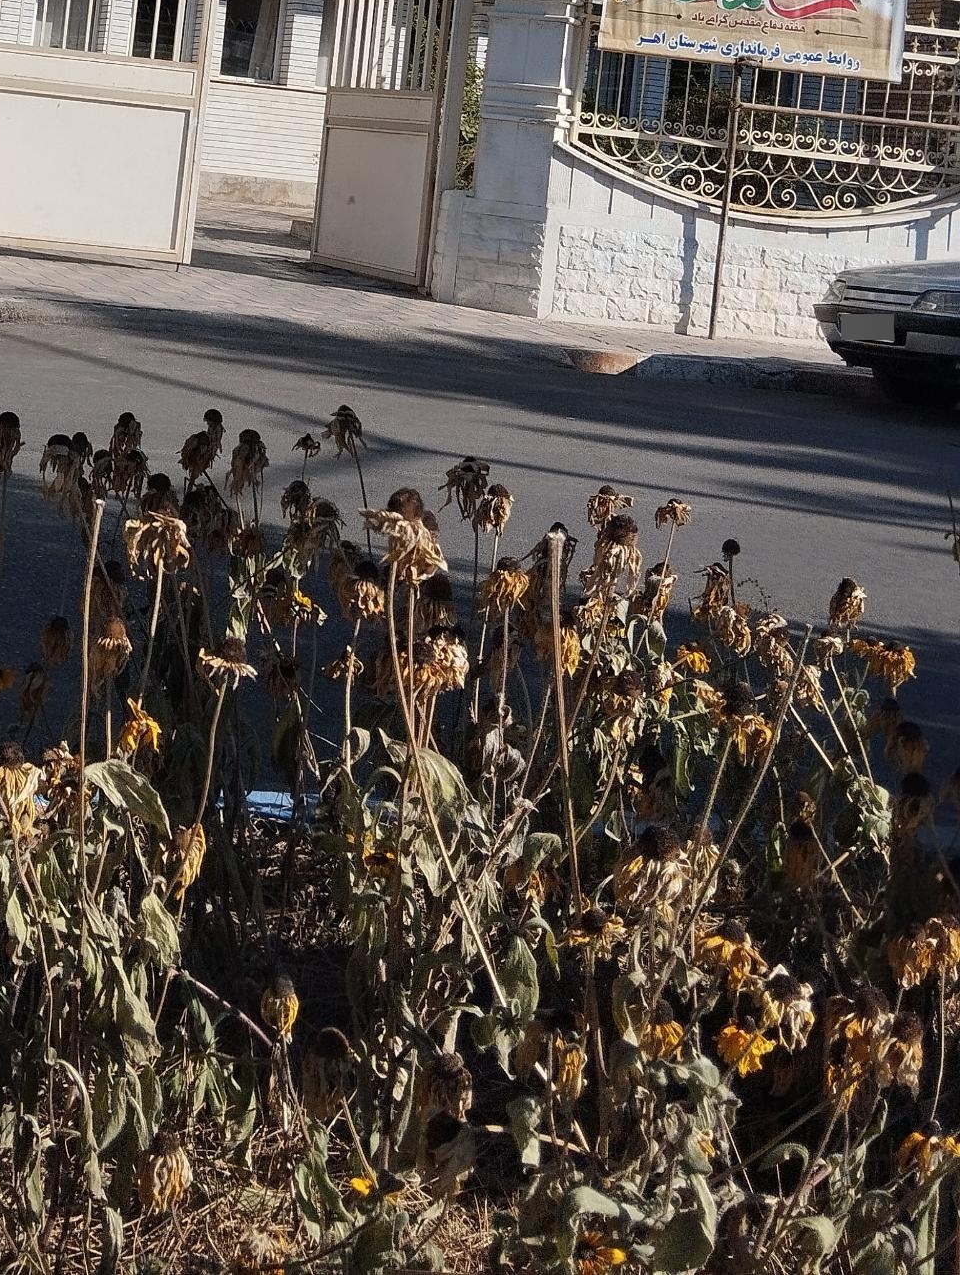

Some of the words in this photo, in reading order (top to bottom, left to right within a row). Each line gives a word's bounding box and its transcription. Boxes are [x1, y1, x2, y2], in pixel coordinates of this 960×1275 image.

[691, 12, 705, 25] باد
[728, 16, 762, 29] مقدس
[761, 19, 783, 34] دفاع
[783, 22, 806, 33] هفته
[636, 32, 666, 47] اهر
[668, 36, 718, 53] شهرستان
[720, 41, 781, 60] فرمانداری
[783, 51, 823, 65] عمومی
[825, 51, 861, 72] روابط
